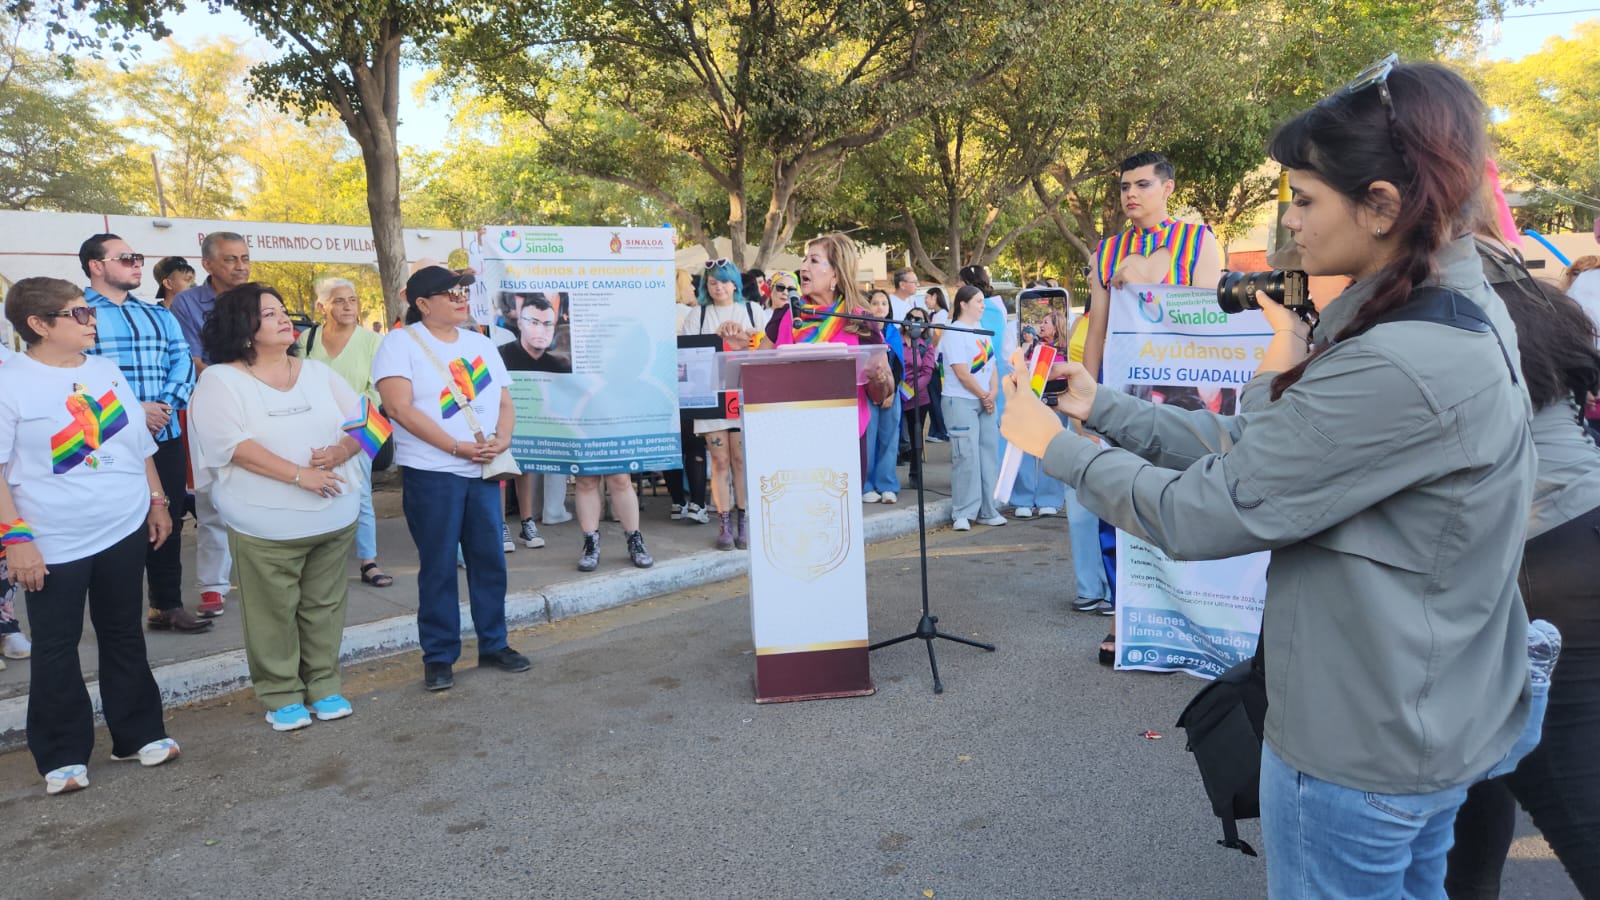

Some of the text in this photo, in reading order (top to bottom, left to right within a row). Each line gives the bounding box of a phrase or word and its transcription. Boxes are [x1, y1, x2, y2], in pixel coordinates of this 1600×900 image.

[257, 235, 322, 250] HERNANDO
[327, 238, 340, 251] DE
[525, 242, 564, 254] Sinaloa
[578, 266, 586, 276] a
[589, 264, 654, 276] encontrar
[500, 280, 666, 290] JESUS GUADALUPE CAMARGO LOYA
[1168, 306, 1228, 324] Sinaloa
[1139, 340, 1265, 363] Ayúdanos a
[1127, 366, 1255, 384] JESUS GUADALU
[537, 439, 581, 448] información
[584, 440, 618, 448] referente
[628, 438, 643, 446] esta
[585, 449, 608, 457] ayuda
[1129, 611, 1142, 623] Si
[1147, 613, 1186, 627] tienes
[1129, 626, 1163, 638] llama
[1166, 630, 1175, 639] o
[1166, 654, 1185, 664] 668
